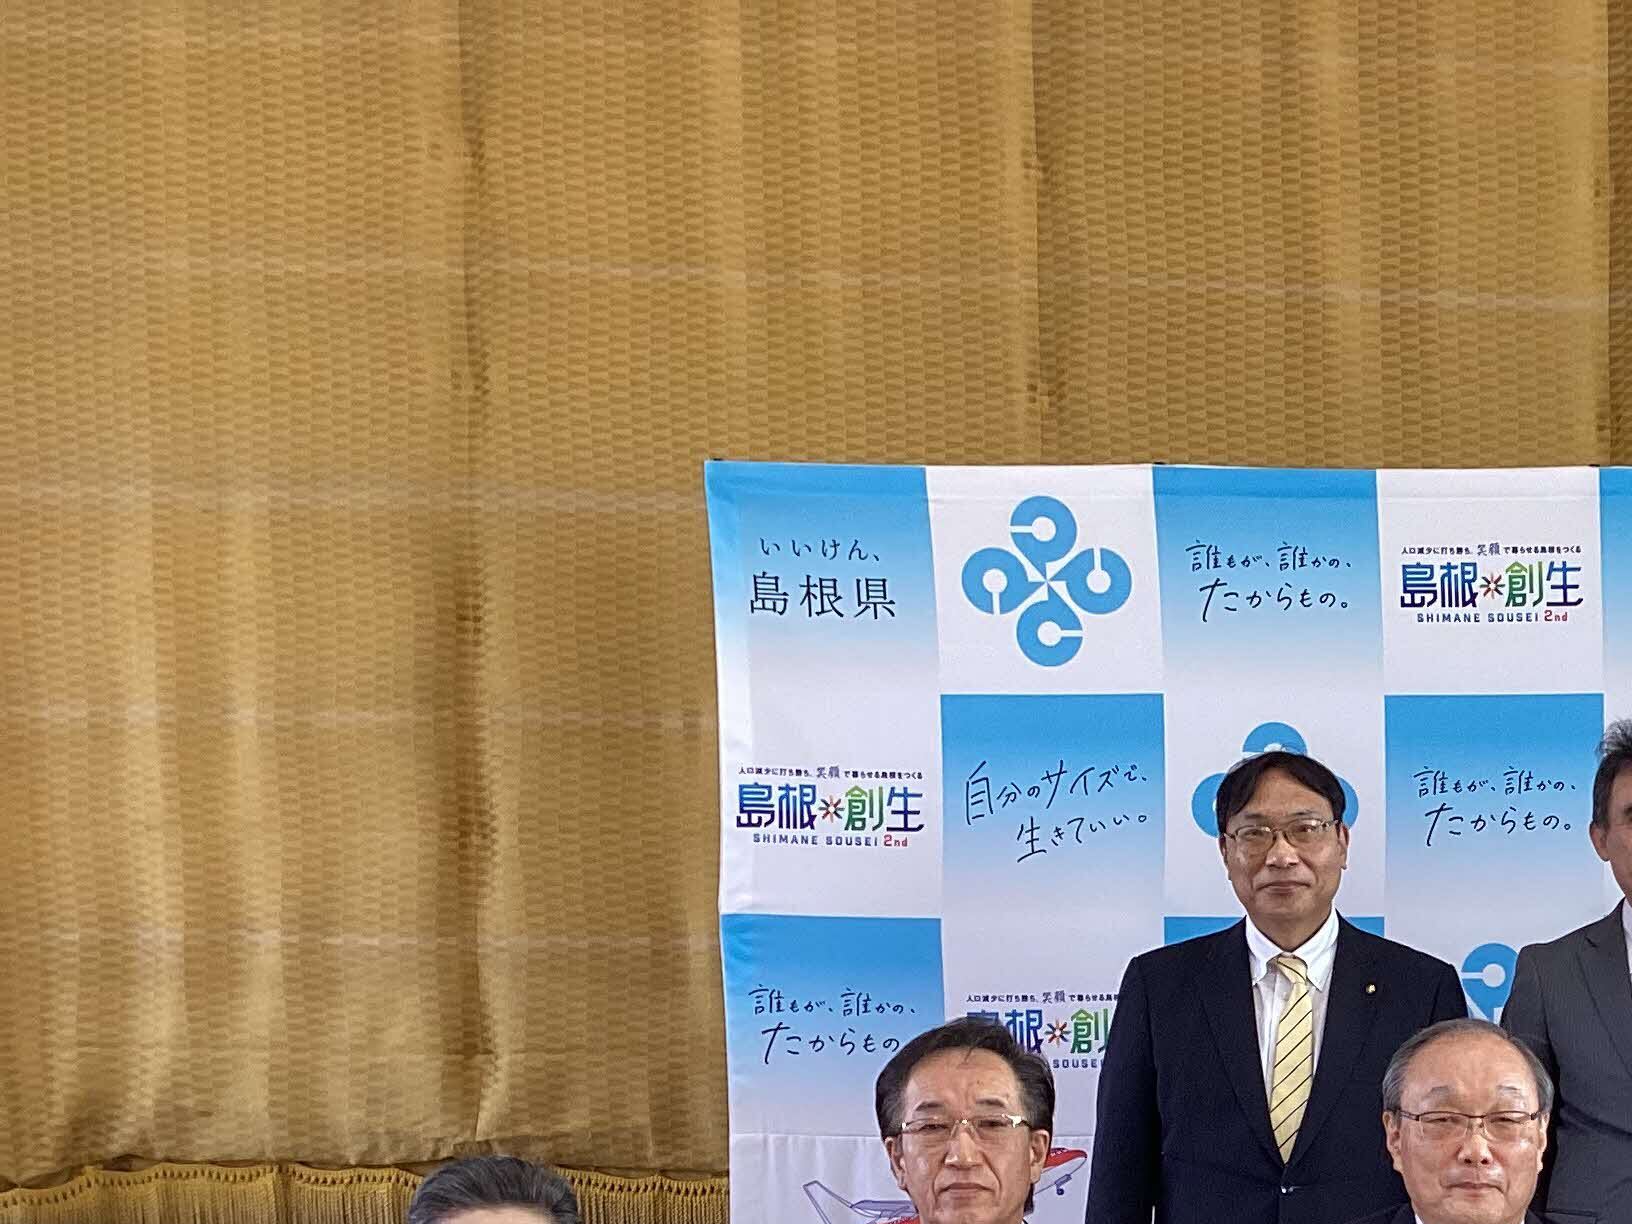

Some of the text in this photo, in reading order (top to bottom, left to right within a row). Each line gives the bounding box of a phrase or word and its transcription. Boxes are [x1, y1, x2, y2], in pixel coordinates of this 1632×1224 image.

[760, 537, 880, 561] いいけん、
[750, 571, 896, 620] 島根県
[1199, 578, 1348, 622] たからもの。
[1417, 610, 1568, 622] SHIMANE SOUSEI 2nd
[966, 760, 1147, 825] 自分のサイズで、
[753, 833, 908, 847] SHIMANE SOUSEI 2nd
[1016, 815, 1147, 863] 生きていい。
[1425, 802, 1571, 846] たからもの。
